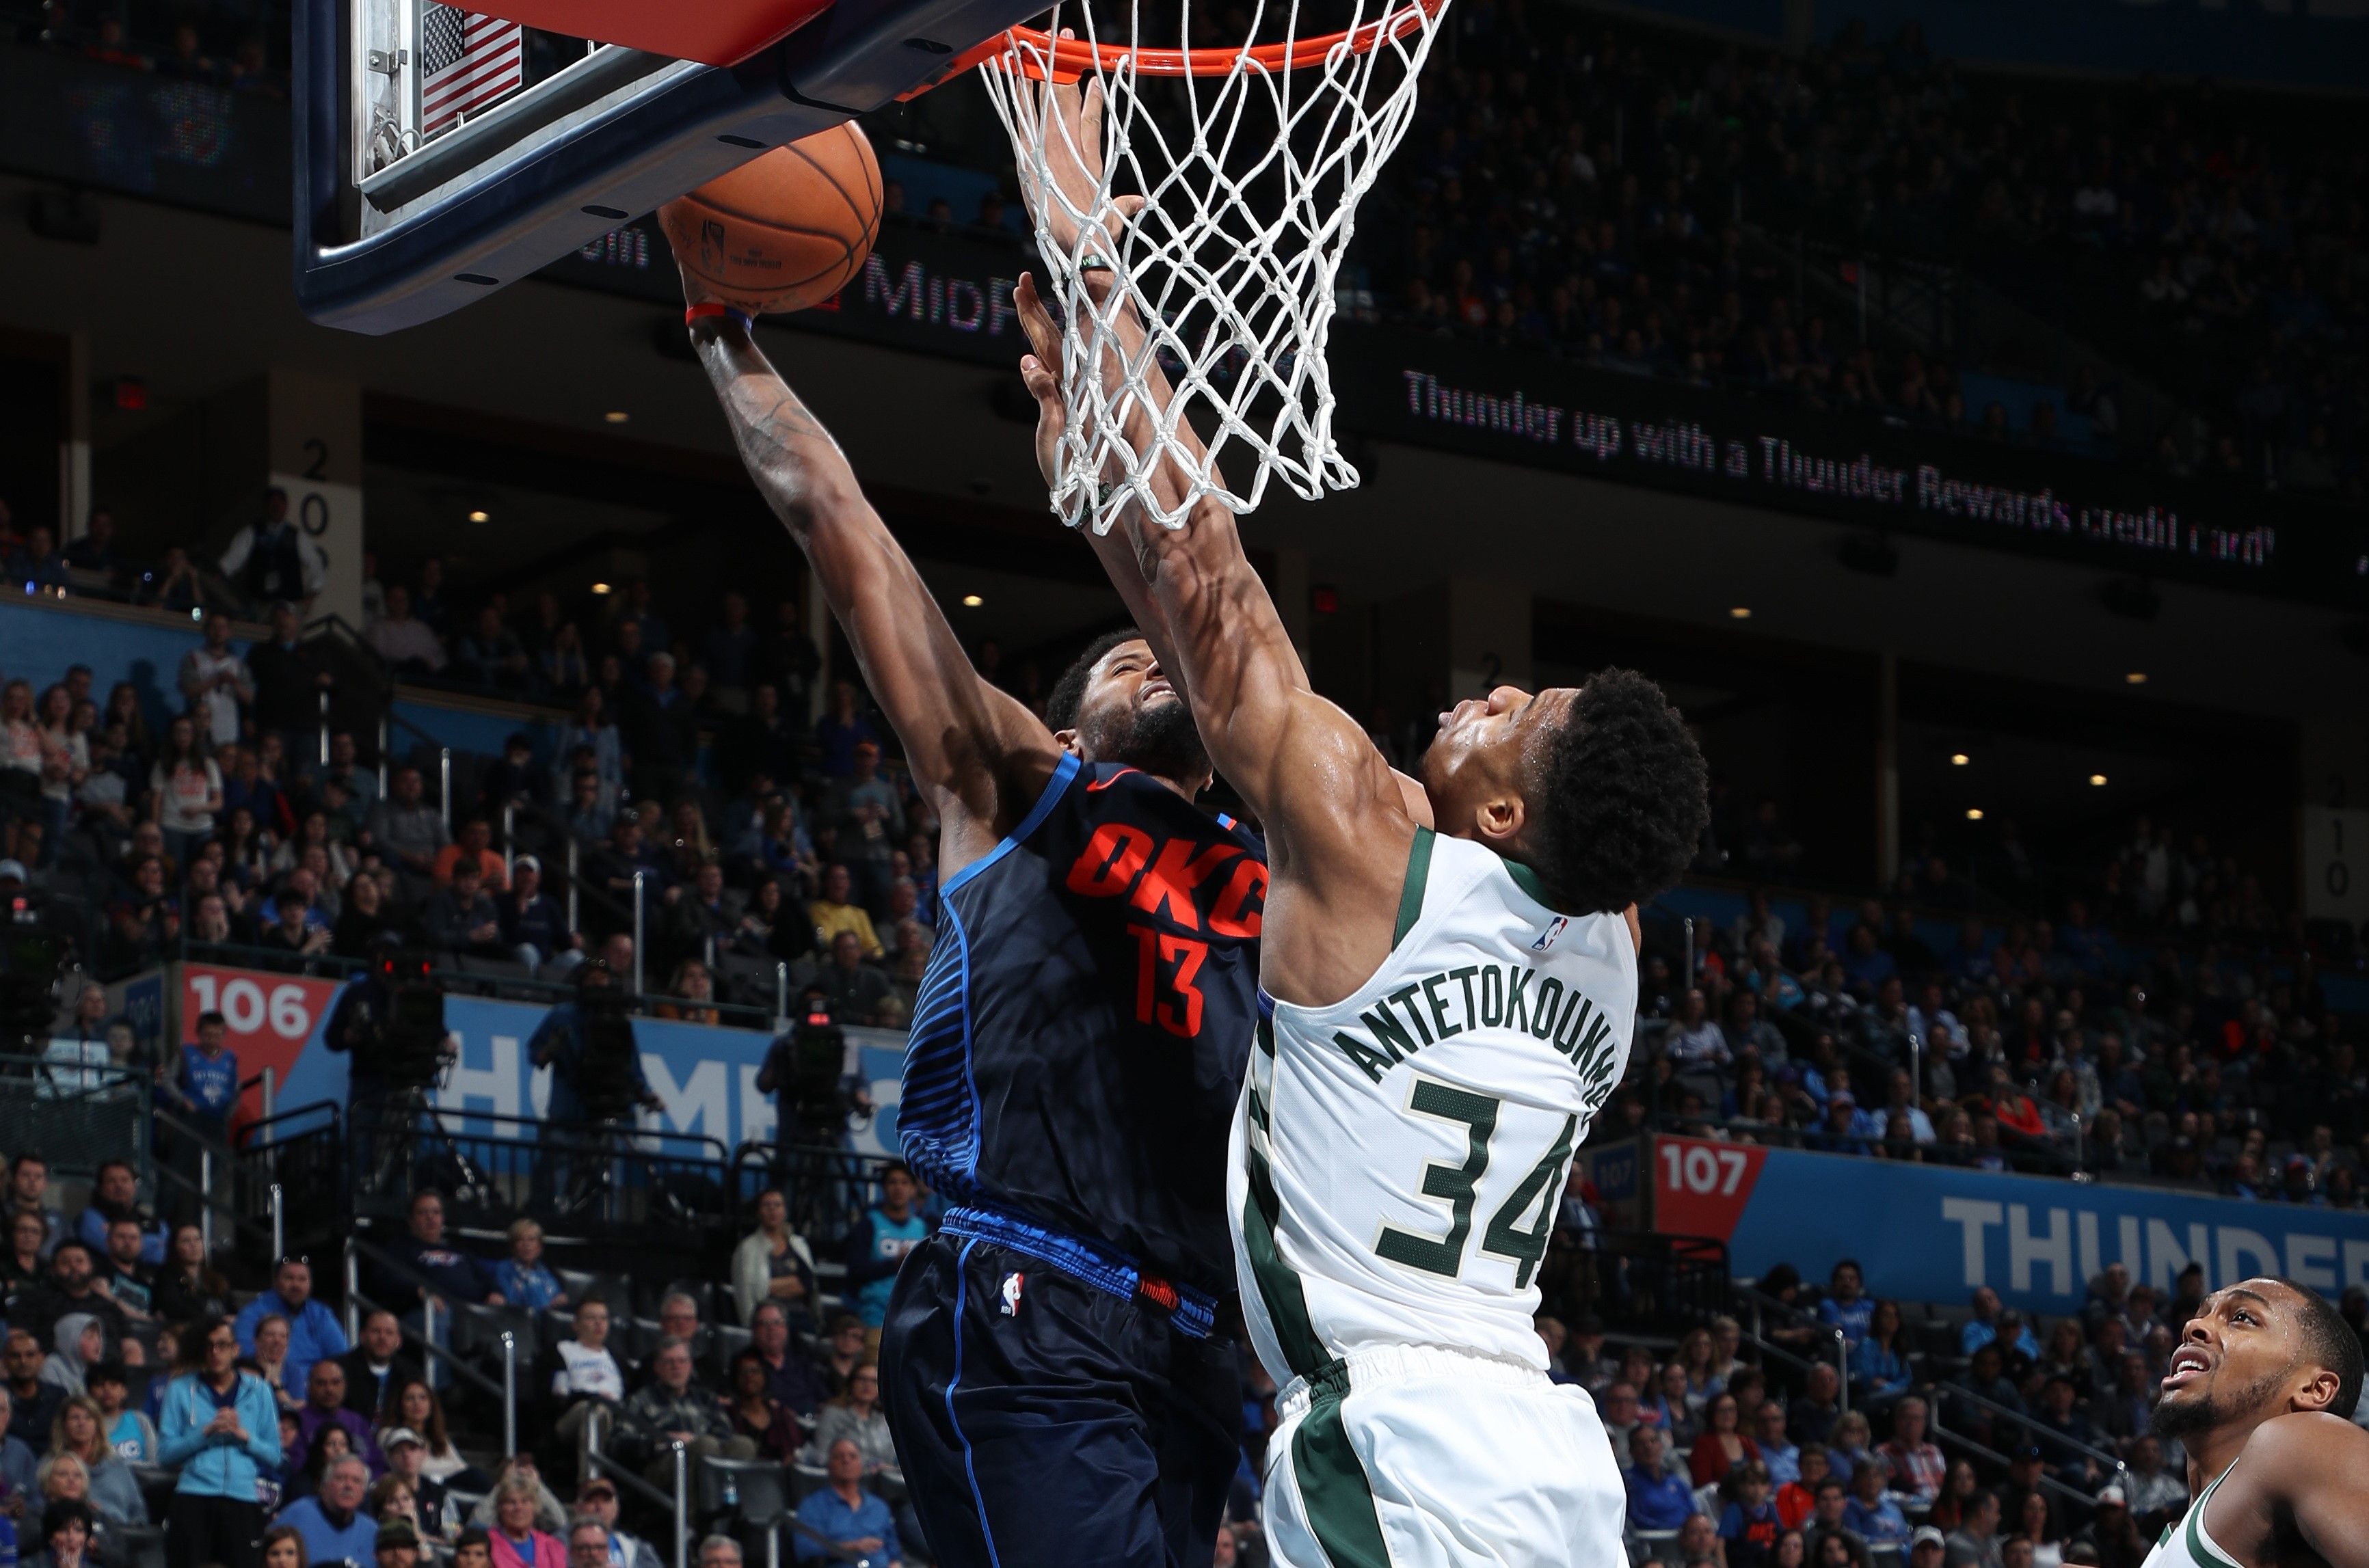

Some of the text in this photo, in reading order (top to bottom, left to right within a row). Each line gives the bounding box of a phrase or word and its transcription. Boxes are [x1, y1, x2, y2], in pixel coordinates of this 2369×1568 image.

[1403, 369, 1564, 444] Thunder
[1572, 410, 1622, 461] up
[1631, 417, 1715, 472] with
[1724, 440, 1749, 478] a
[1758, 435, 1908, 504] Thunder
[1065, 822, 1270, 938] OKC
[190, 974, 310, 1040] 106
[1126, 922, 1209, 1039] 13
[1371, 1073, 1579, 1292] 34
[1660, 1144, 1748, 1196] 107
